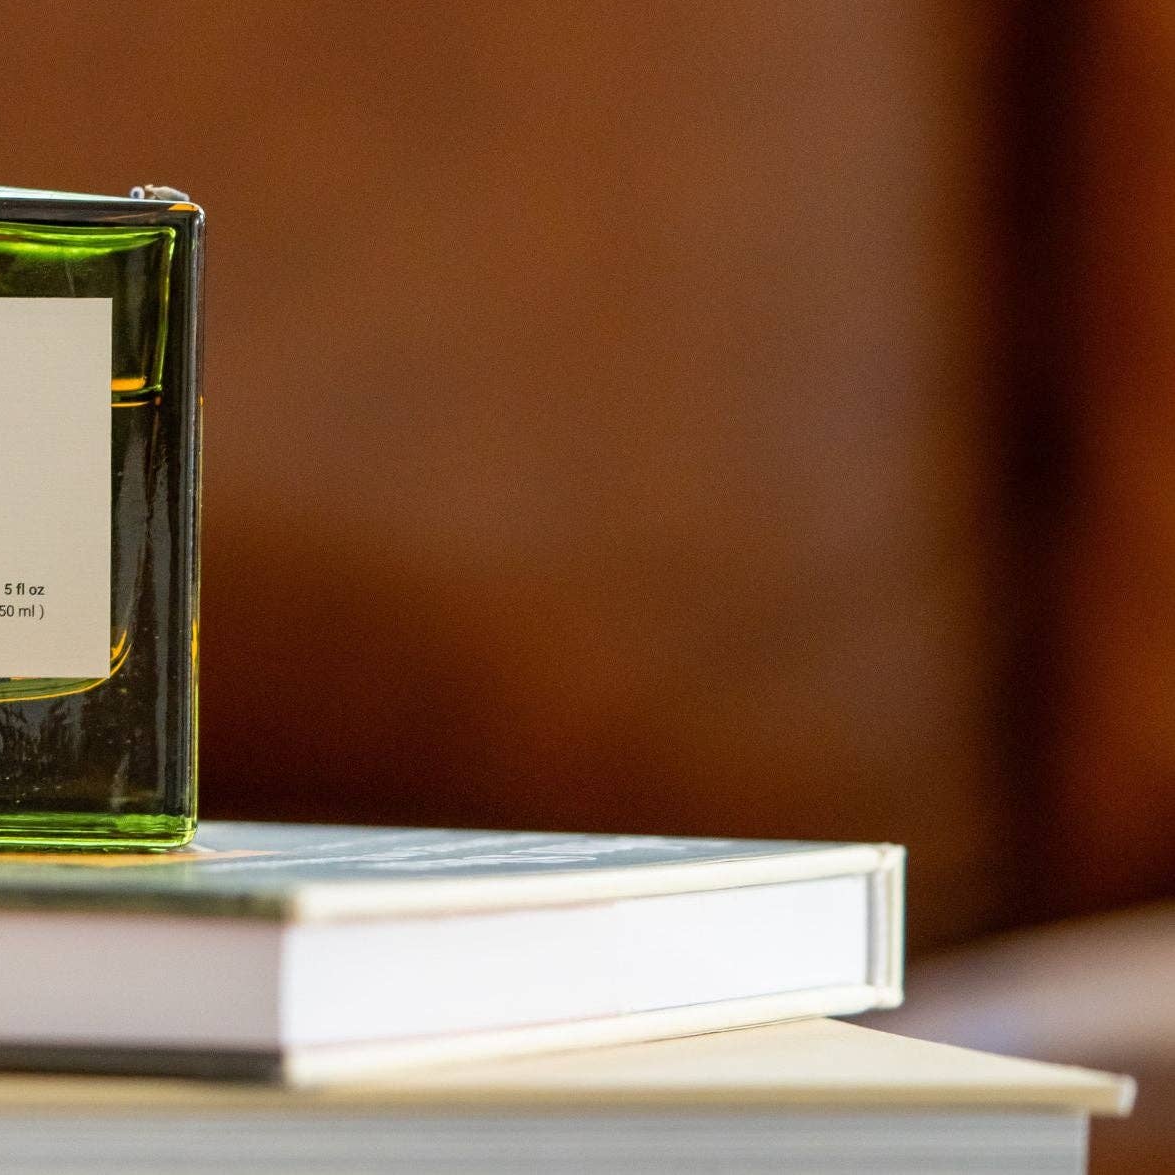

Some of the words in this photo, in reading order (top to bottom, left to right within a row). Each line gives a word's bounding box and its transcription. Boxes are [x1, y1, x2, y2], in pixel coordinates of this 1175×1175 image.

[3, 582, 13, 596] 5
[15, 582, 25, 596] fl
[28, 585, 46, 596] oz
